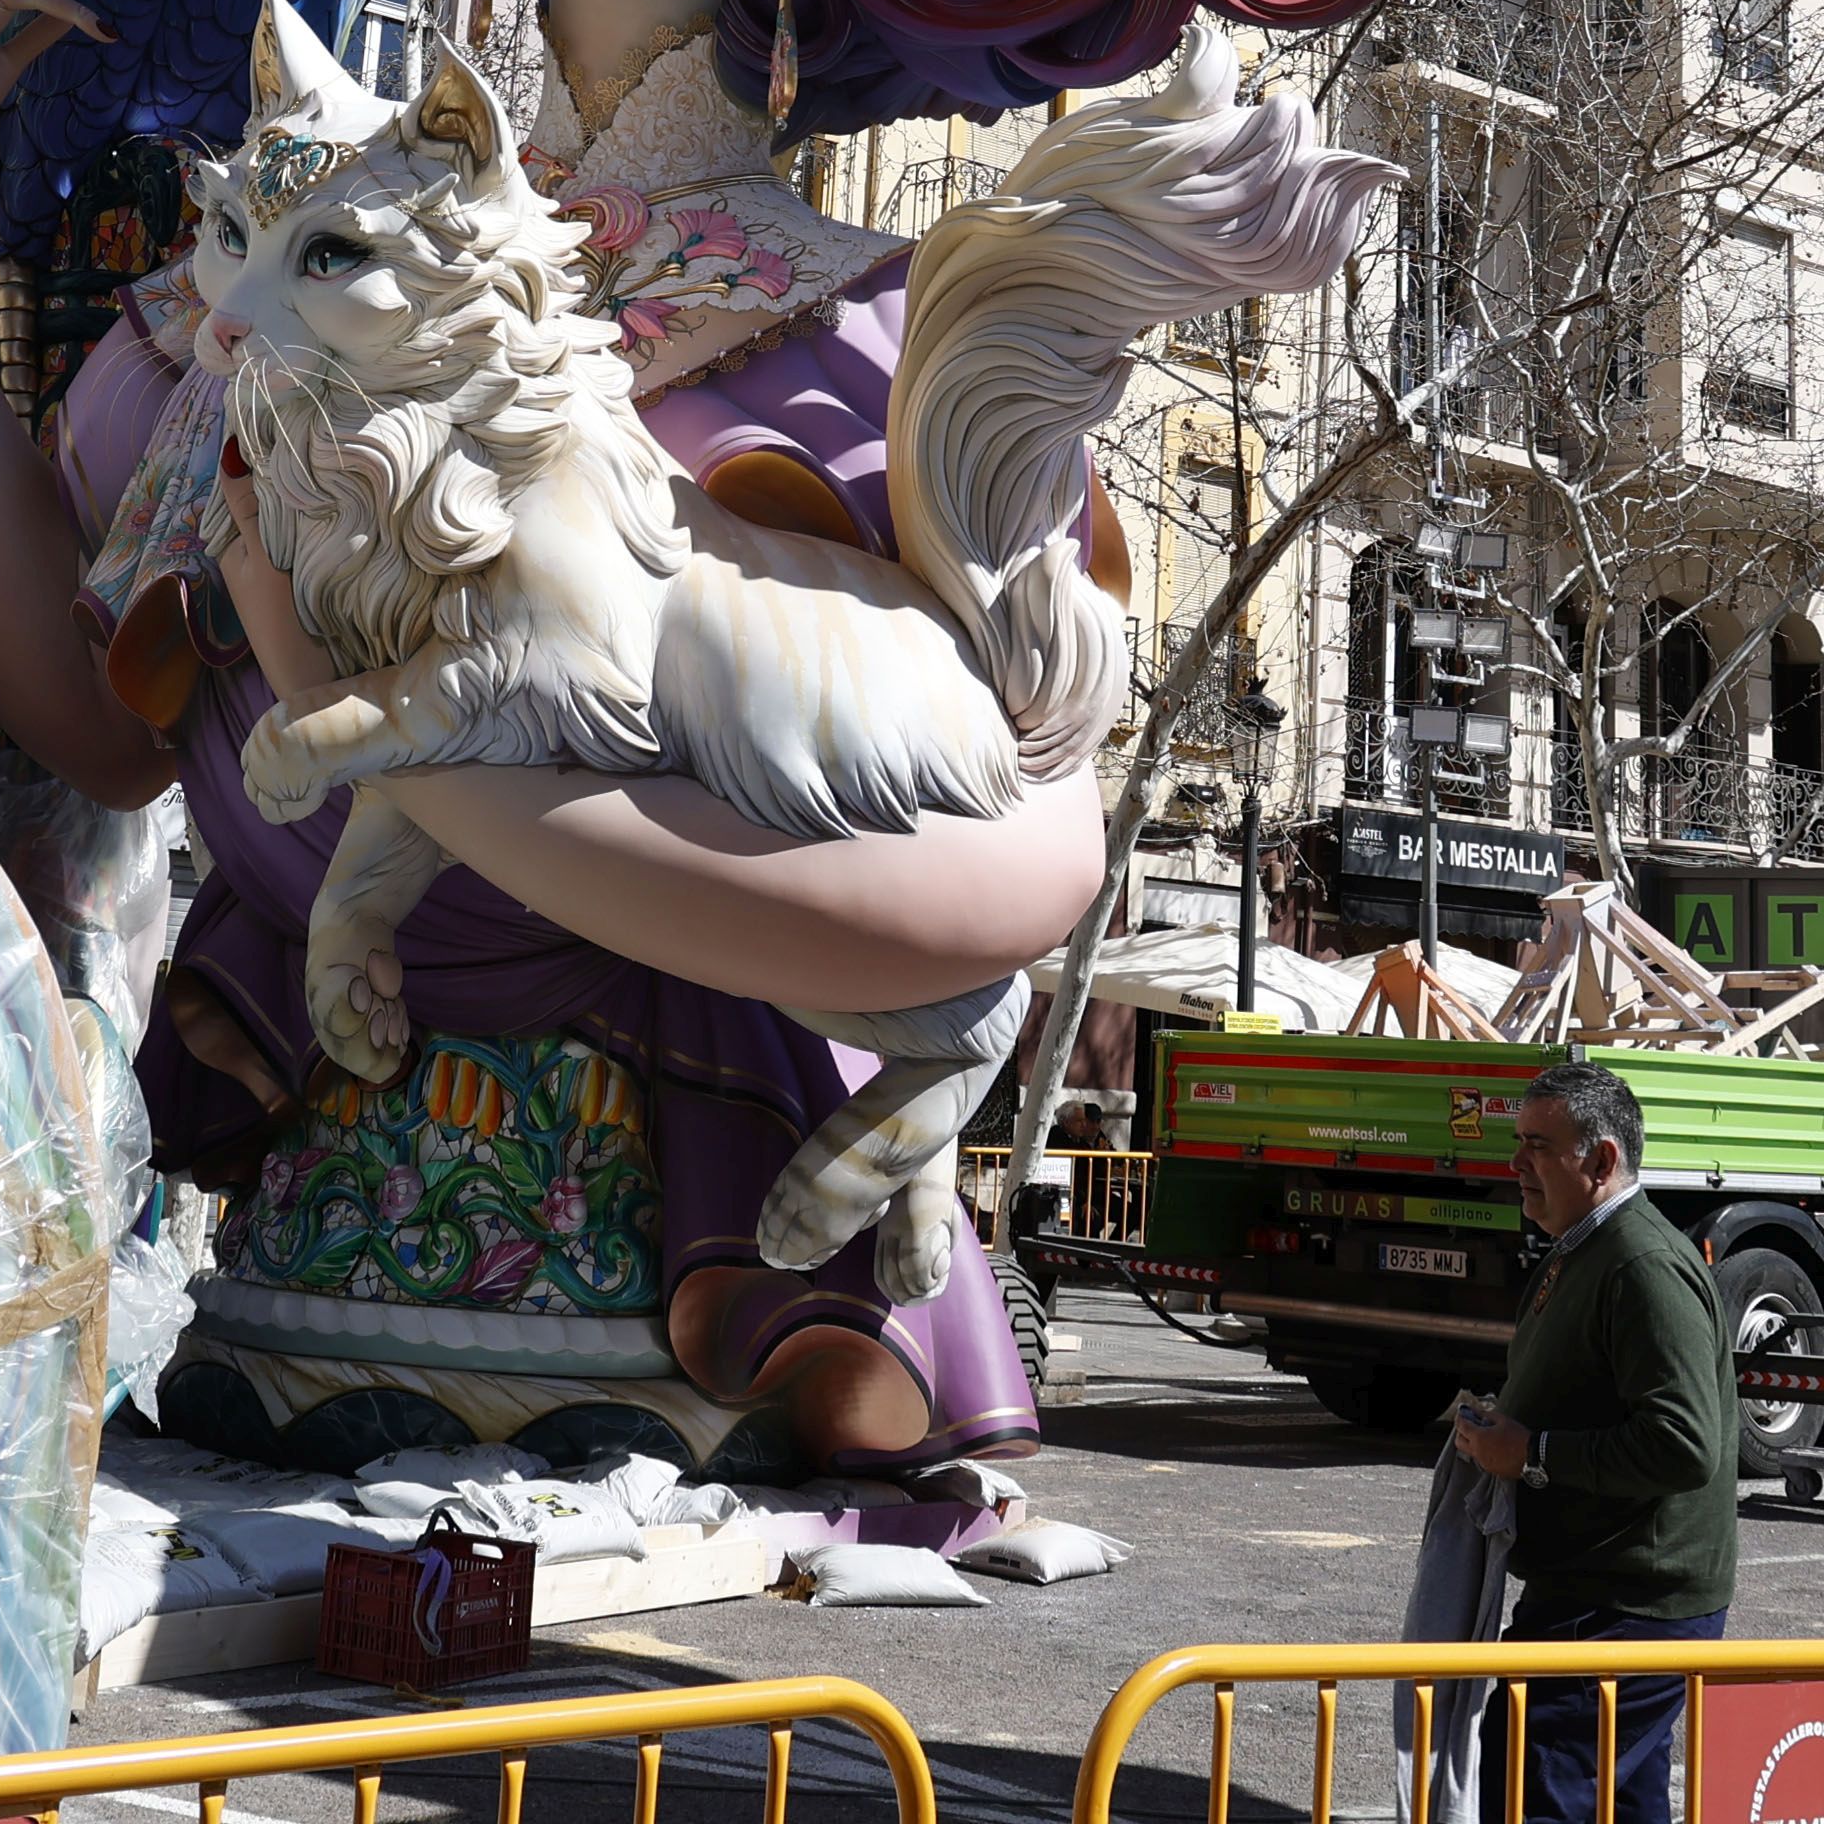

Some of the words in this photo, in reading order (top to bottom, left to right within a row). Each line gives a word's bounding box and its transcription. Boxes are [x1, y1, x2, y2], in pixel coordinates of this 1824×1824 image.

[1449, 840, 1559, 878] MESTALLA
[1179, 992, 1215, 1012] Mahou
[1210, 1083, 1233, 1096] VIEL
[1504, 1098, 1523, 1111] VIE
[1308, 1124, 1409, 1144] www.atsasl.com
[1286, 1189, 1391, 1218] GRUAS
[1429, 1204, 1493, 1222] altiplano
[1390, 1248, 1427, 1270] 8735
[1433, 1253, 1464, 1275] MMJ
